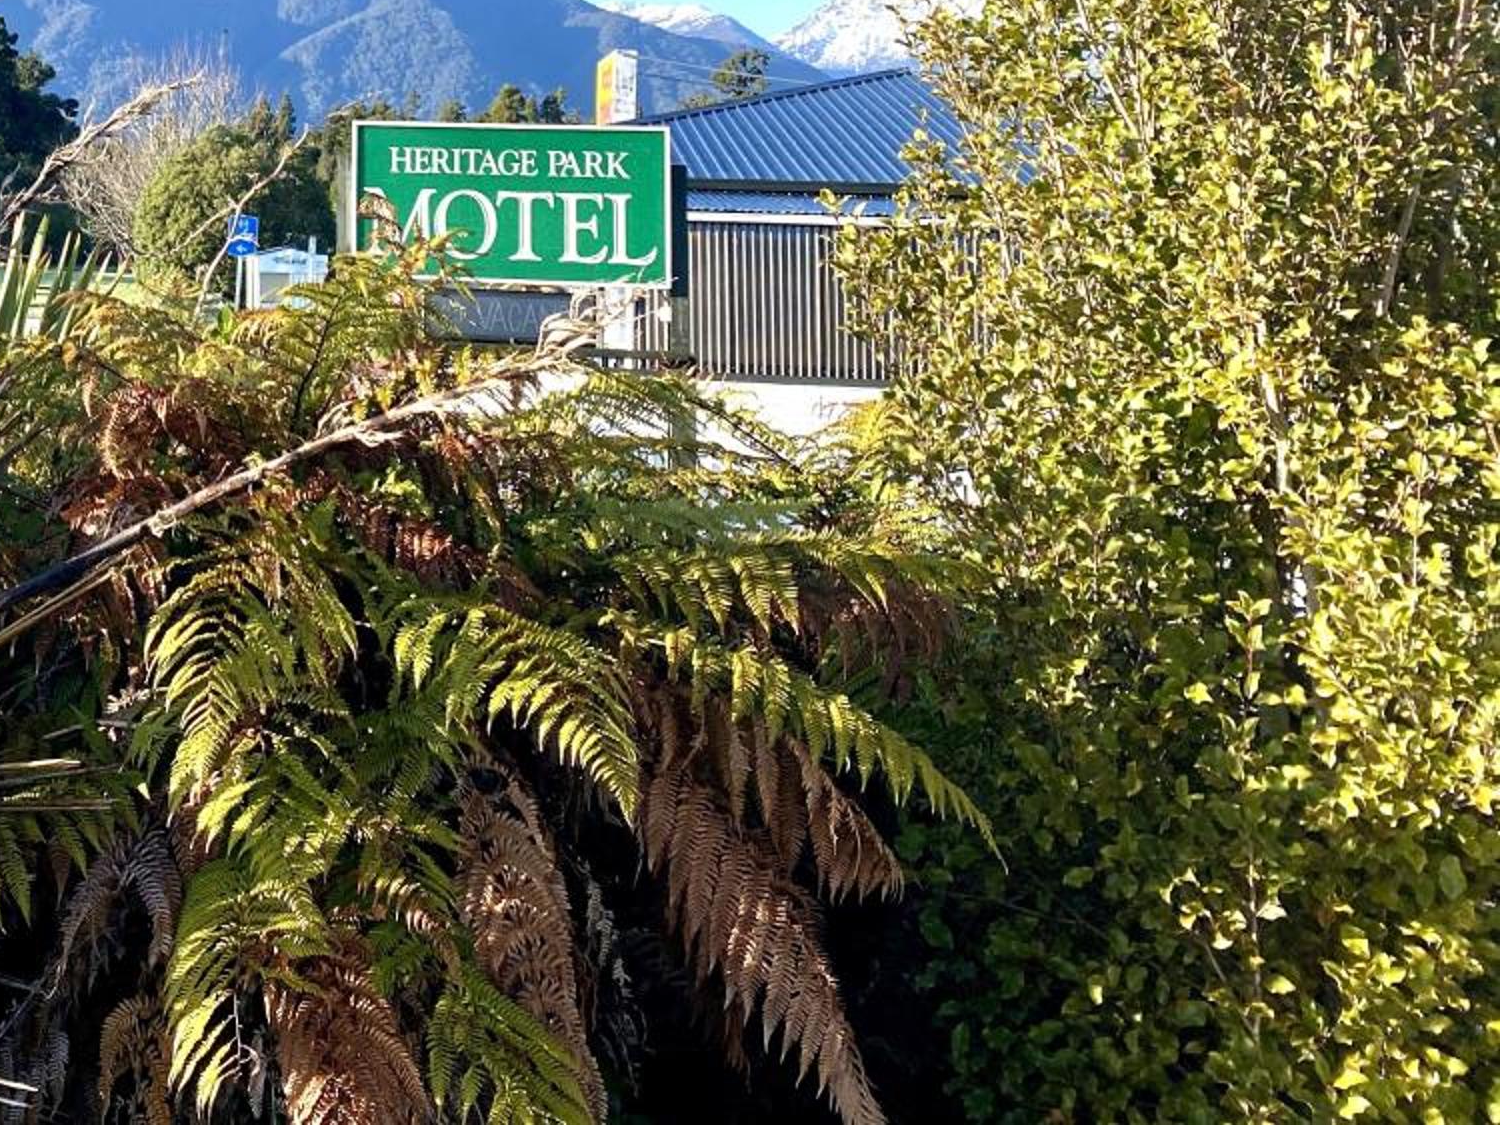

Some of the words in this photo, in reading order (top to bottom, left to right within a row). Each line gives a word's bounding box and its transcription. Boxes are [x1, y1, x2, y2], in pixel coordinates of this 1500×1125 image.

[388, 146, 539, 177] HERITAGE
[547, 150, 631, 180] PARK
[363, 186, 658, 267] MOTEL
[475, 297, 546, 332] VACA
